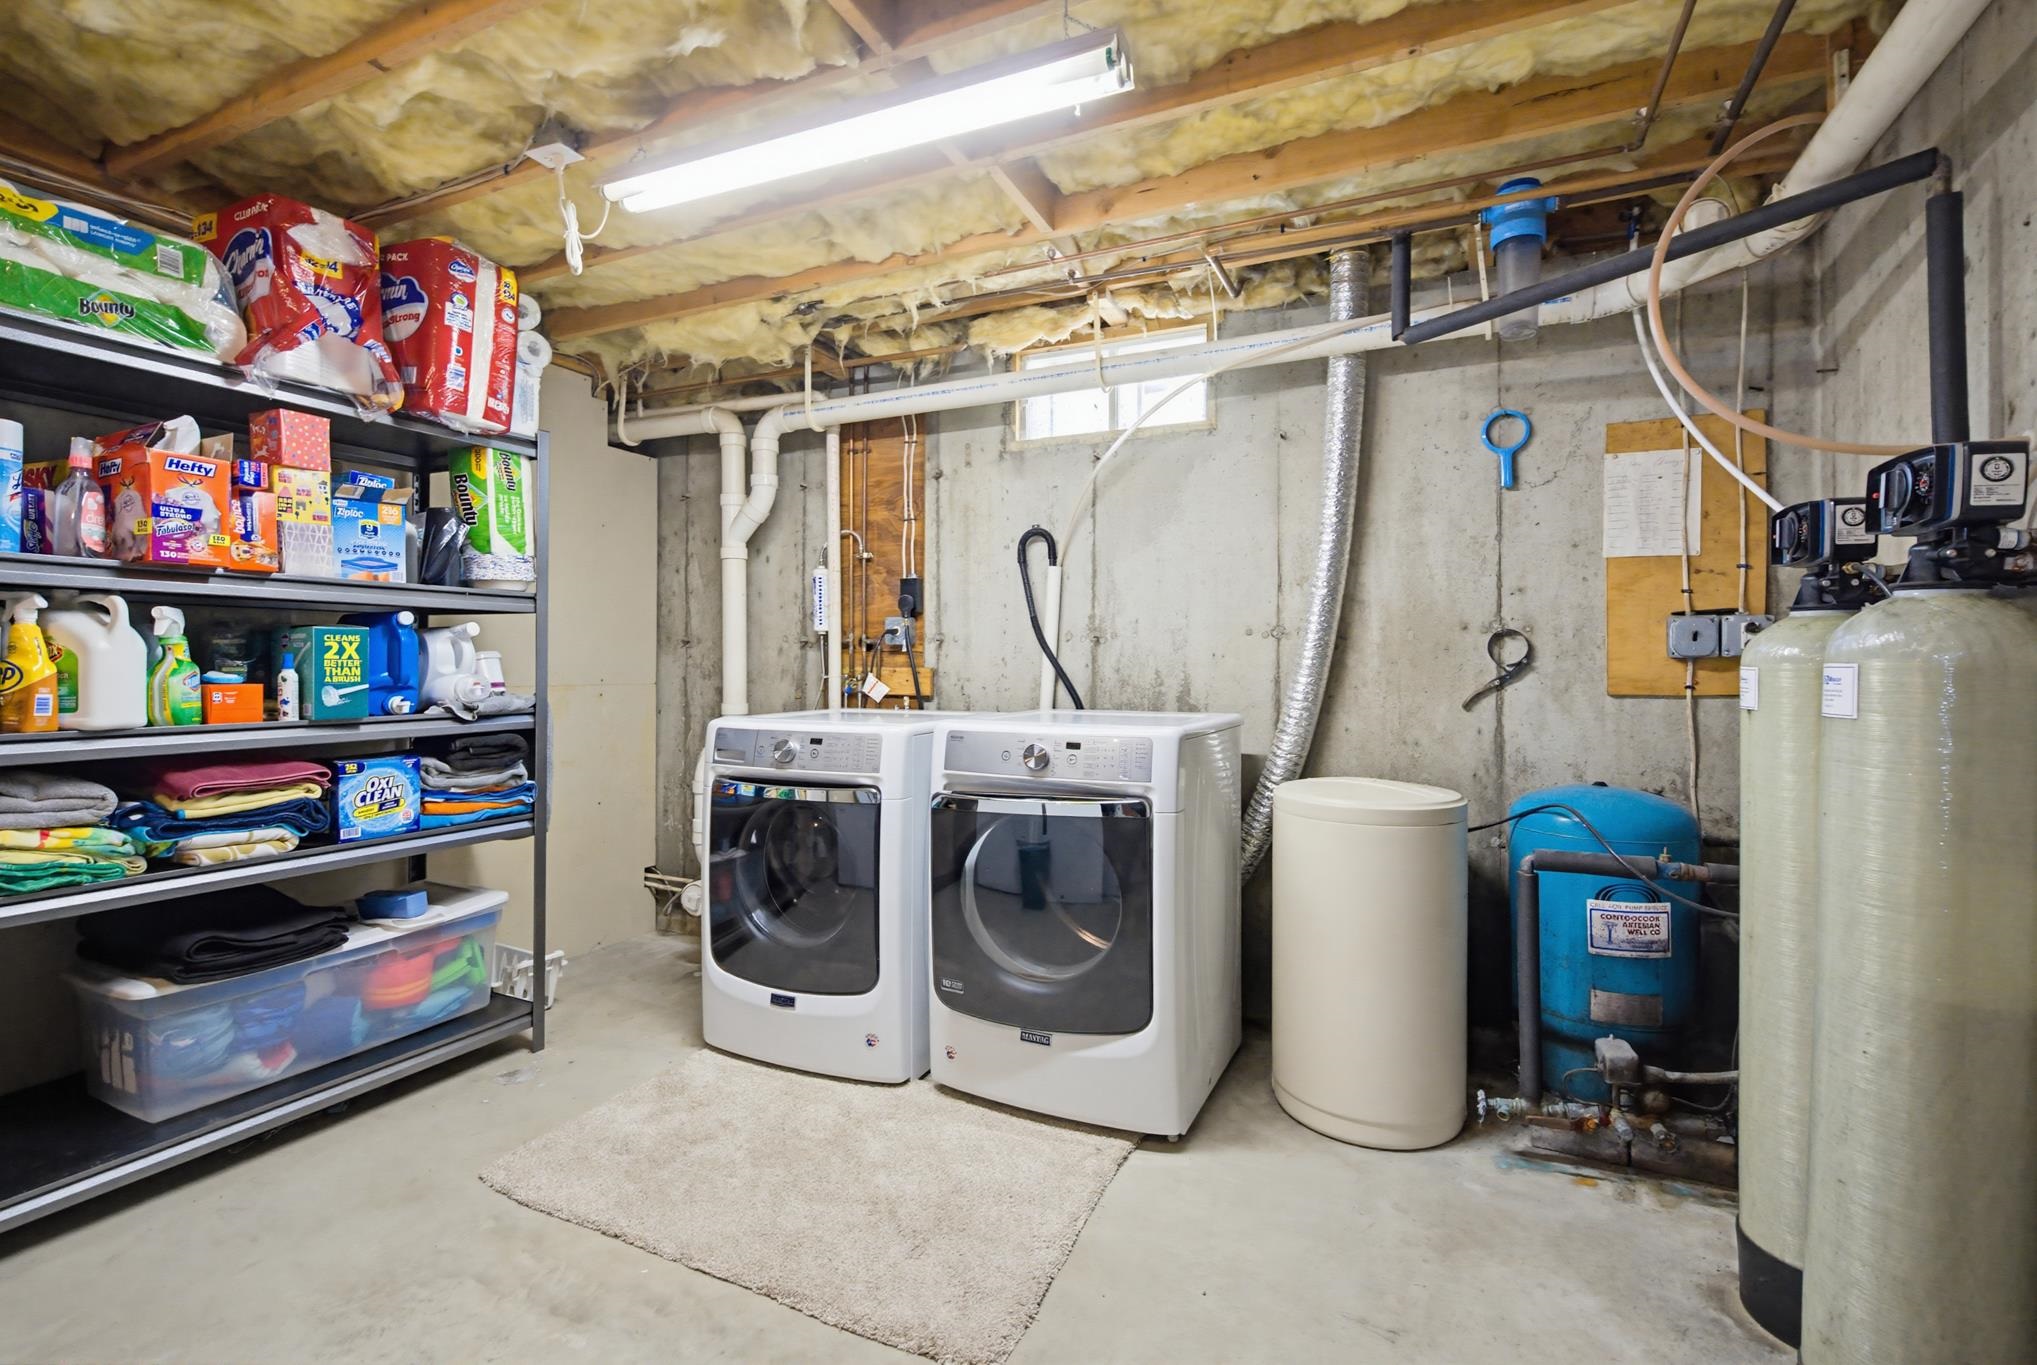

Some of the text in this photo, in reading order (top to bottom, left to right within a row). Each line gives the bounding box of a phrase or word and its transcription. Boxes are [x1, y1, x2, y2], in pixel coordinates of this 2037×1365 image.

[79, 297, 136, 318] Bounty
[167, 458, 214, 477] Hefty
[500, 451, 516, 492] Bounty
[358, 475, 388, 489] Ziploc
[454, 473, 478, 526] Bounty
[159, 505, 187, 515] ULTRA
[336, 507, 365, 520] Ziploc
[365, 523, 374, 532] 9
[159, 550, 178, 560] 130
[323, 634, 361, 642] CLEANS
[323, 641, 361, 660] 2X
[323, 659, 361, 668] BETTER
[324, 667, 361, 676] THAN
[366, 776, 395, 793] OXI
[354, 784, 404, 808] CLEAN
[1622, 921, 1661, 929] ARTESIAN
[1022, 1032, 1049, 1045] MAYTAG
